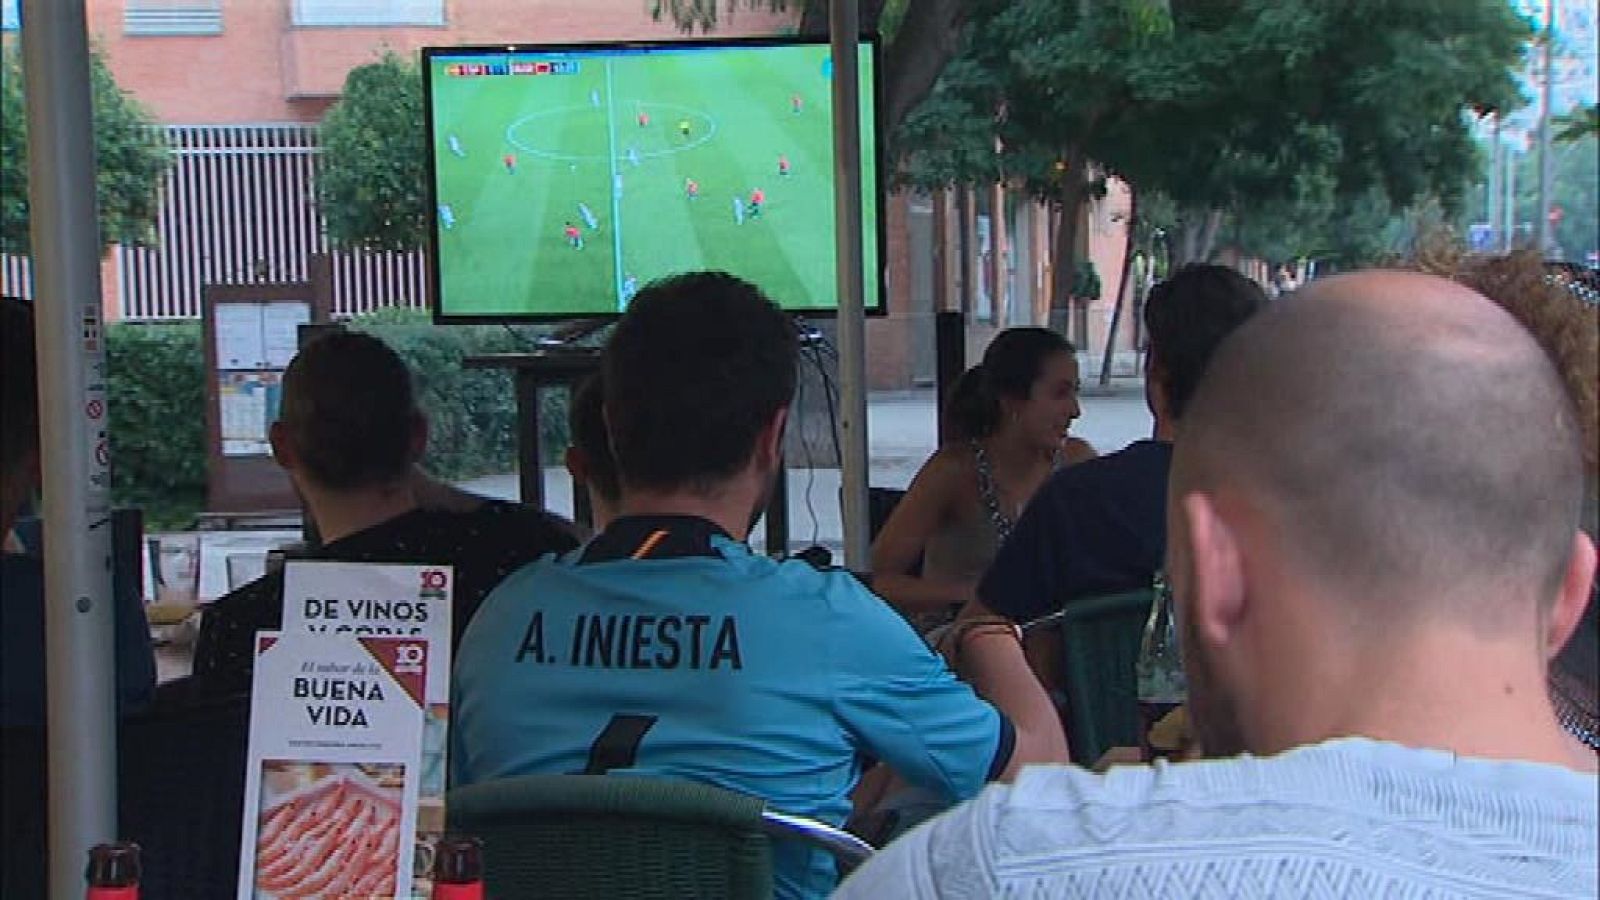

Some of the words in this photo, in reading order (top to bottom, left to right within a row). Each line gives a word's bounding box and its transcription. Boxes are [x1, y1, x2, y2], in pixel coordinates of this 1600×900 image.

[305, 599, 338, 619] DE
[347, 600, 428, 622] VINOS
[516, 611, 555, 663] A.
[572, 614, 742, 669] INIESTA
[294, 678, 384, 700] BUENA
[306, 706, 367, 726] VIDA
